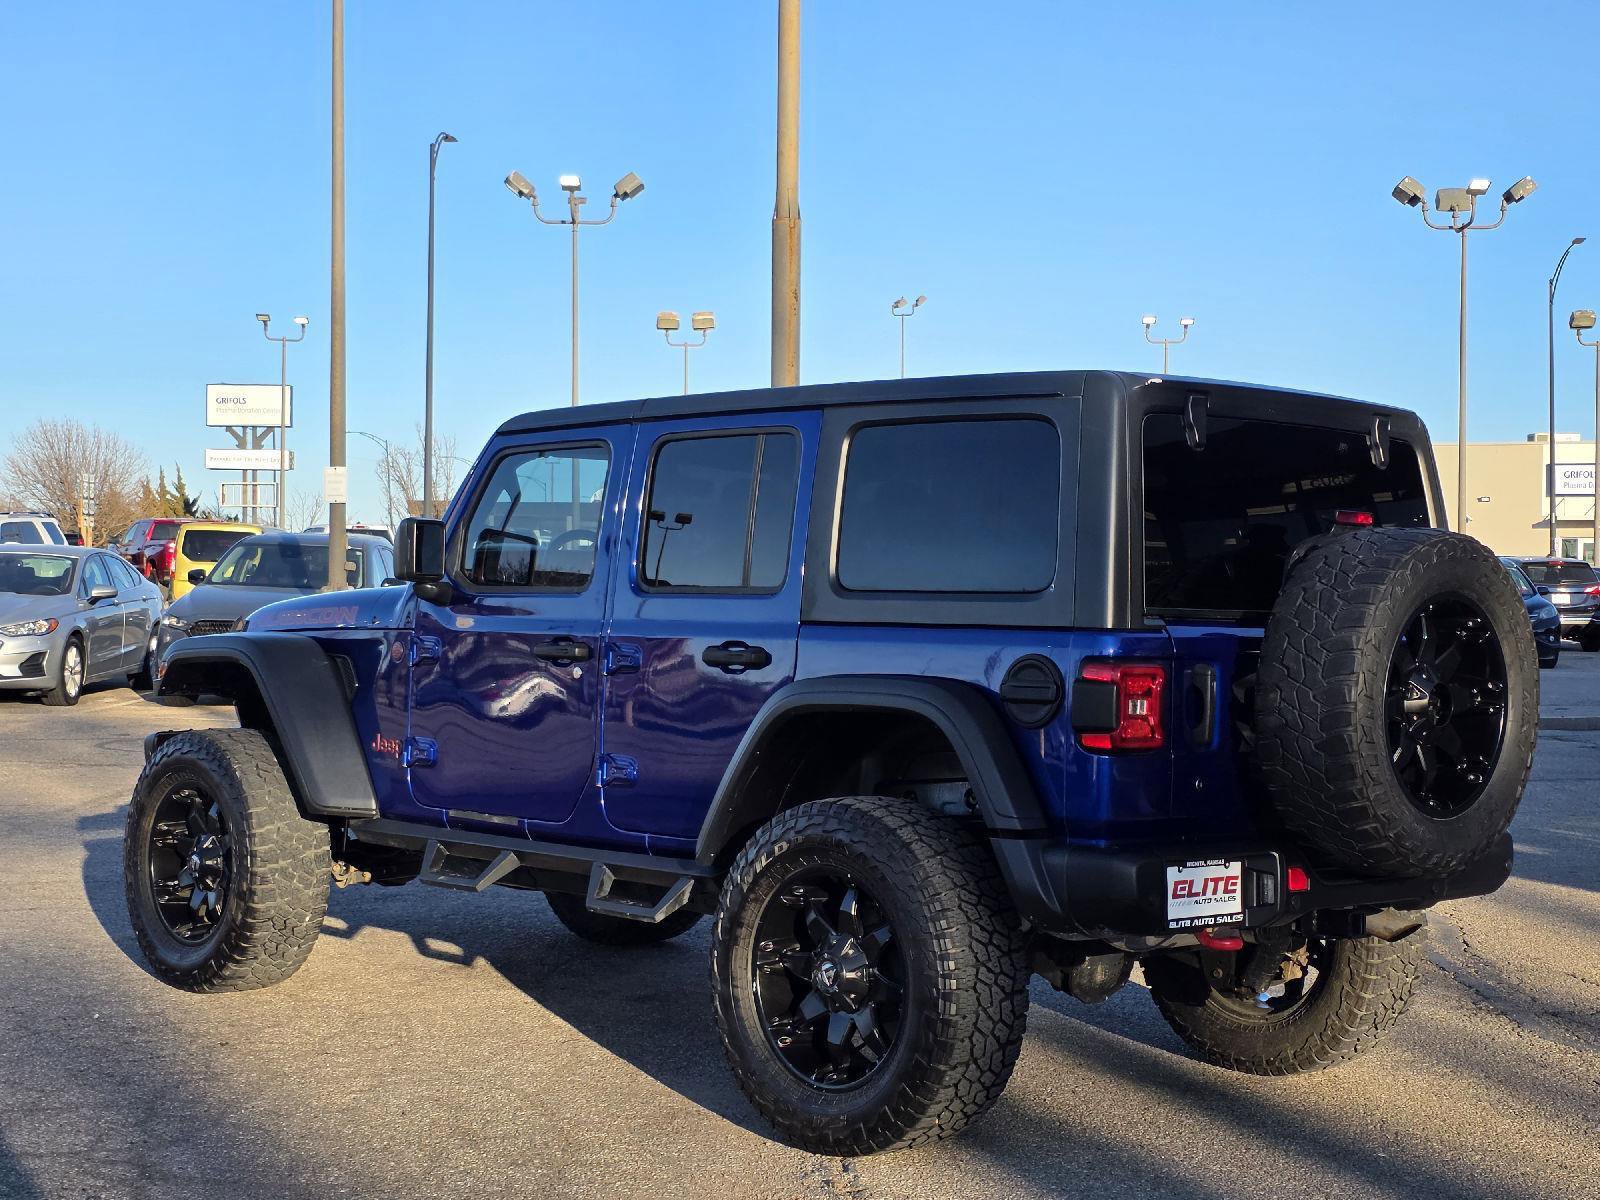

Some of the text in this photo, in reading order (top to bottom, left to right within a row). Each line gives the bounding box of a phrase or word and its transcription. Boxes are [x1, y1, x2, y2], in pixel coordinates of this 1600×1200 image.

[216, 397, 247, 405] GRIFOLS
[1563, 470, 1594, 479] GRIFOL
[371, 733, 400, 759] Jeep
[1171, 875, 1240, 900] ELITE
[1193, 897, 1212, 905] AUTO
[1168, 914, 1244, 929] ELITE AUTO SALES
